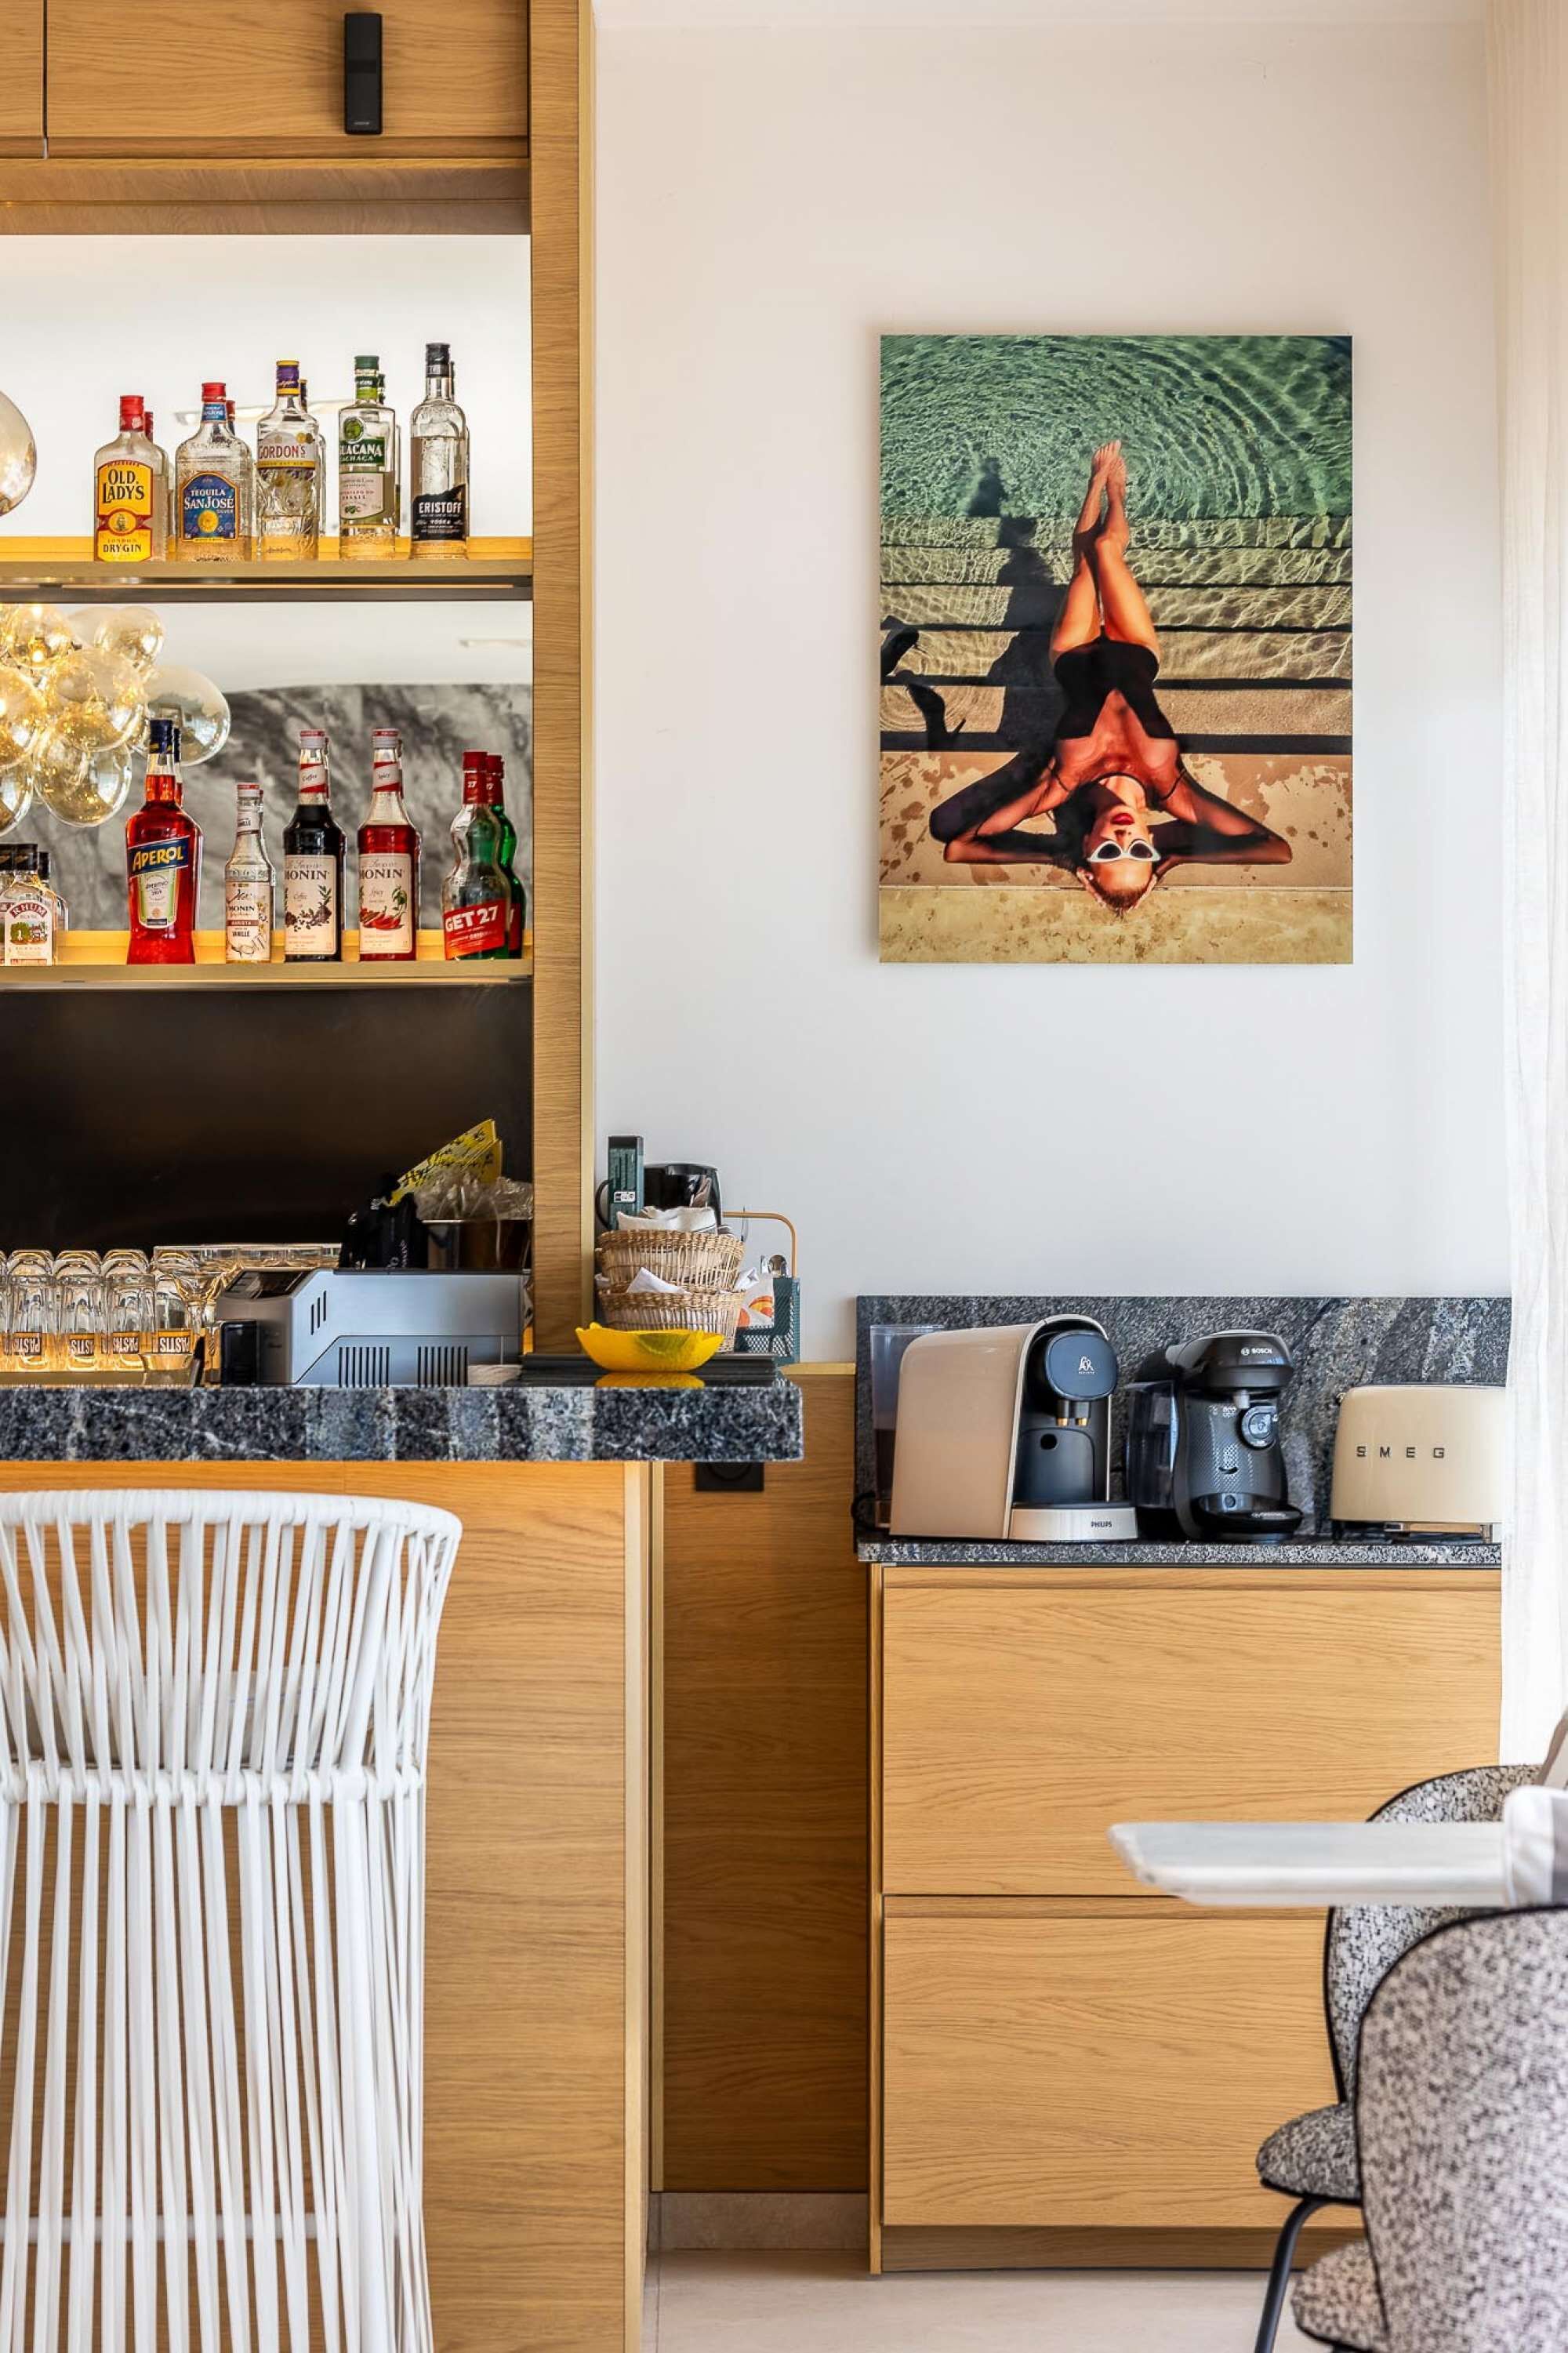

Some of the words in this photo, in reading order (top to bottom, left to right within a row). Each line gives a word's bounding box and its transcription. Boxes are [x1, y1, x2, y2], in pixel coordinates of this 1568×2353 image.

[107, 468, 136, 485] OLD
[191, 488, 226, 497] TEQUILA
[419, 502, 462, 514] ERISTOFF
[122, 544, 142, 553] GIN
[132, 846, 184, 872] APEROL
[10, 902, 47, 918] RHUM
[445, 911, 476, 932] GET
[477, 905, 499, 924] 27
[1356, 1446, 1444, 1458] SMEG
